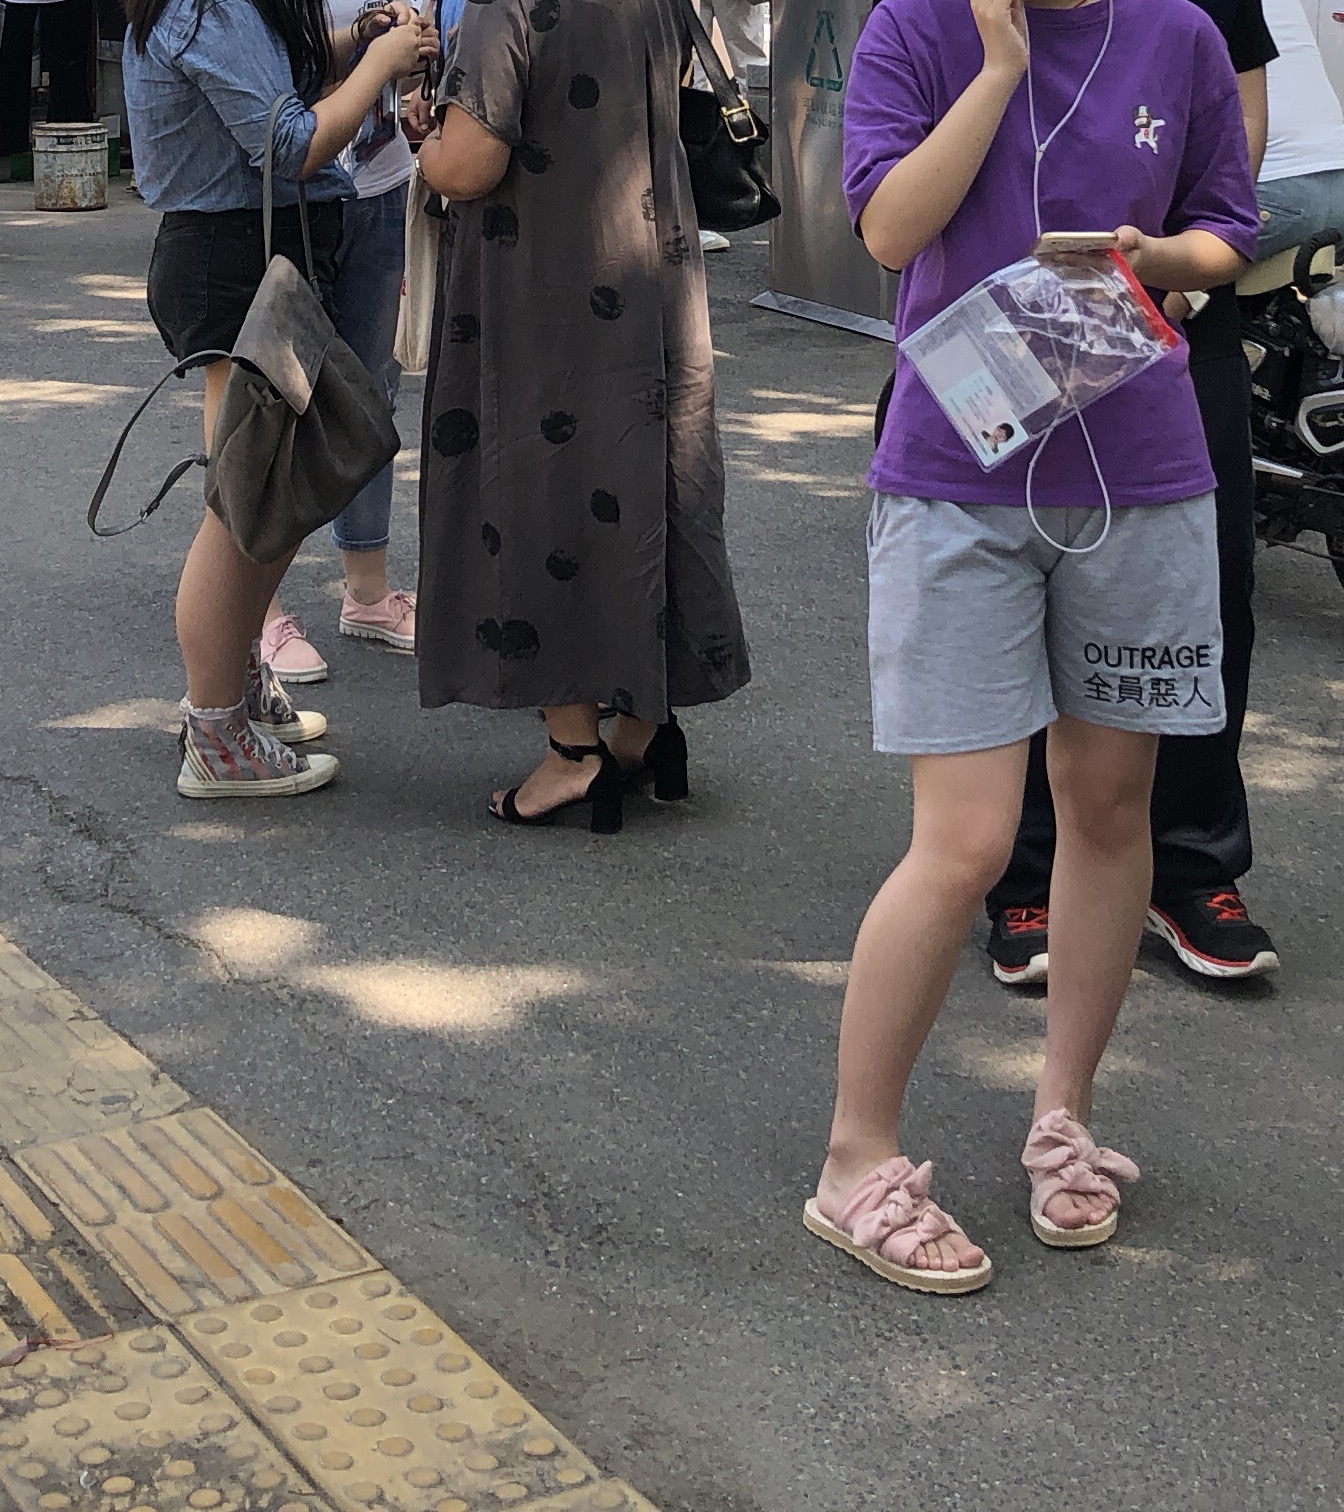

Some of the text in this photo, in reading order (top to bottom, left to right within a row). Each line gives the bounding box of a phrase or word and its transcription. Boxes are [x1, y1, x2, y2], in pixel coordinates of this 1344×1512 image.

[1084, 642, 1211, 670] OUTRAGE
[1083, 672, 1213, 708] 全員惡人
